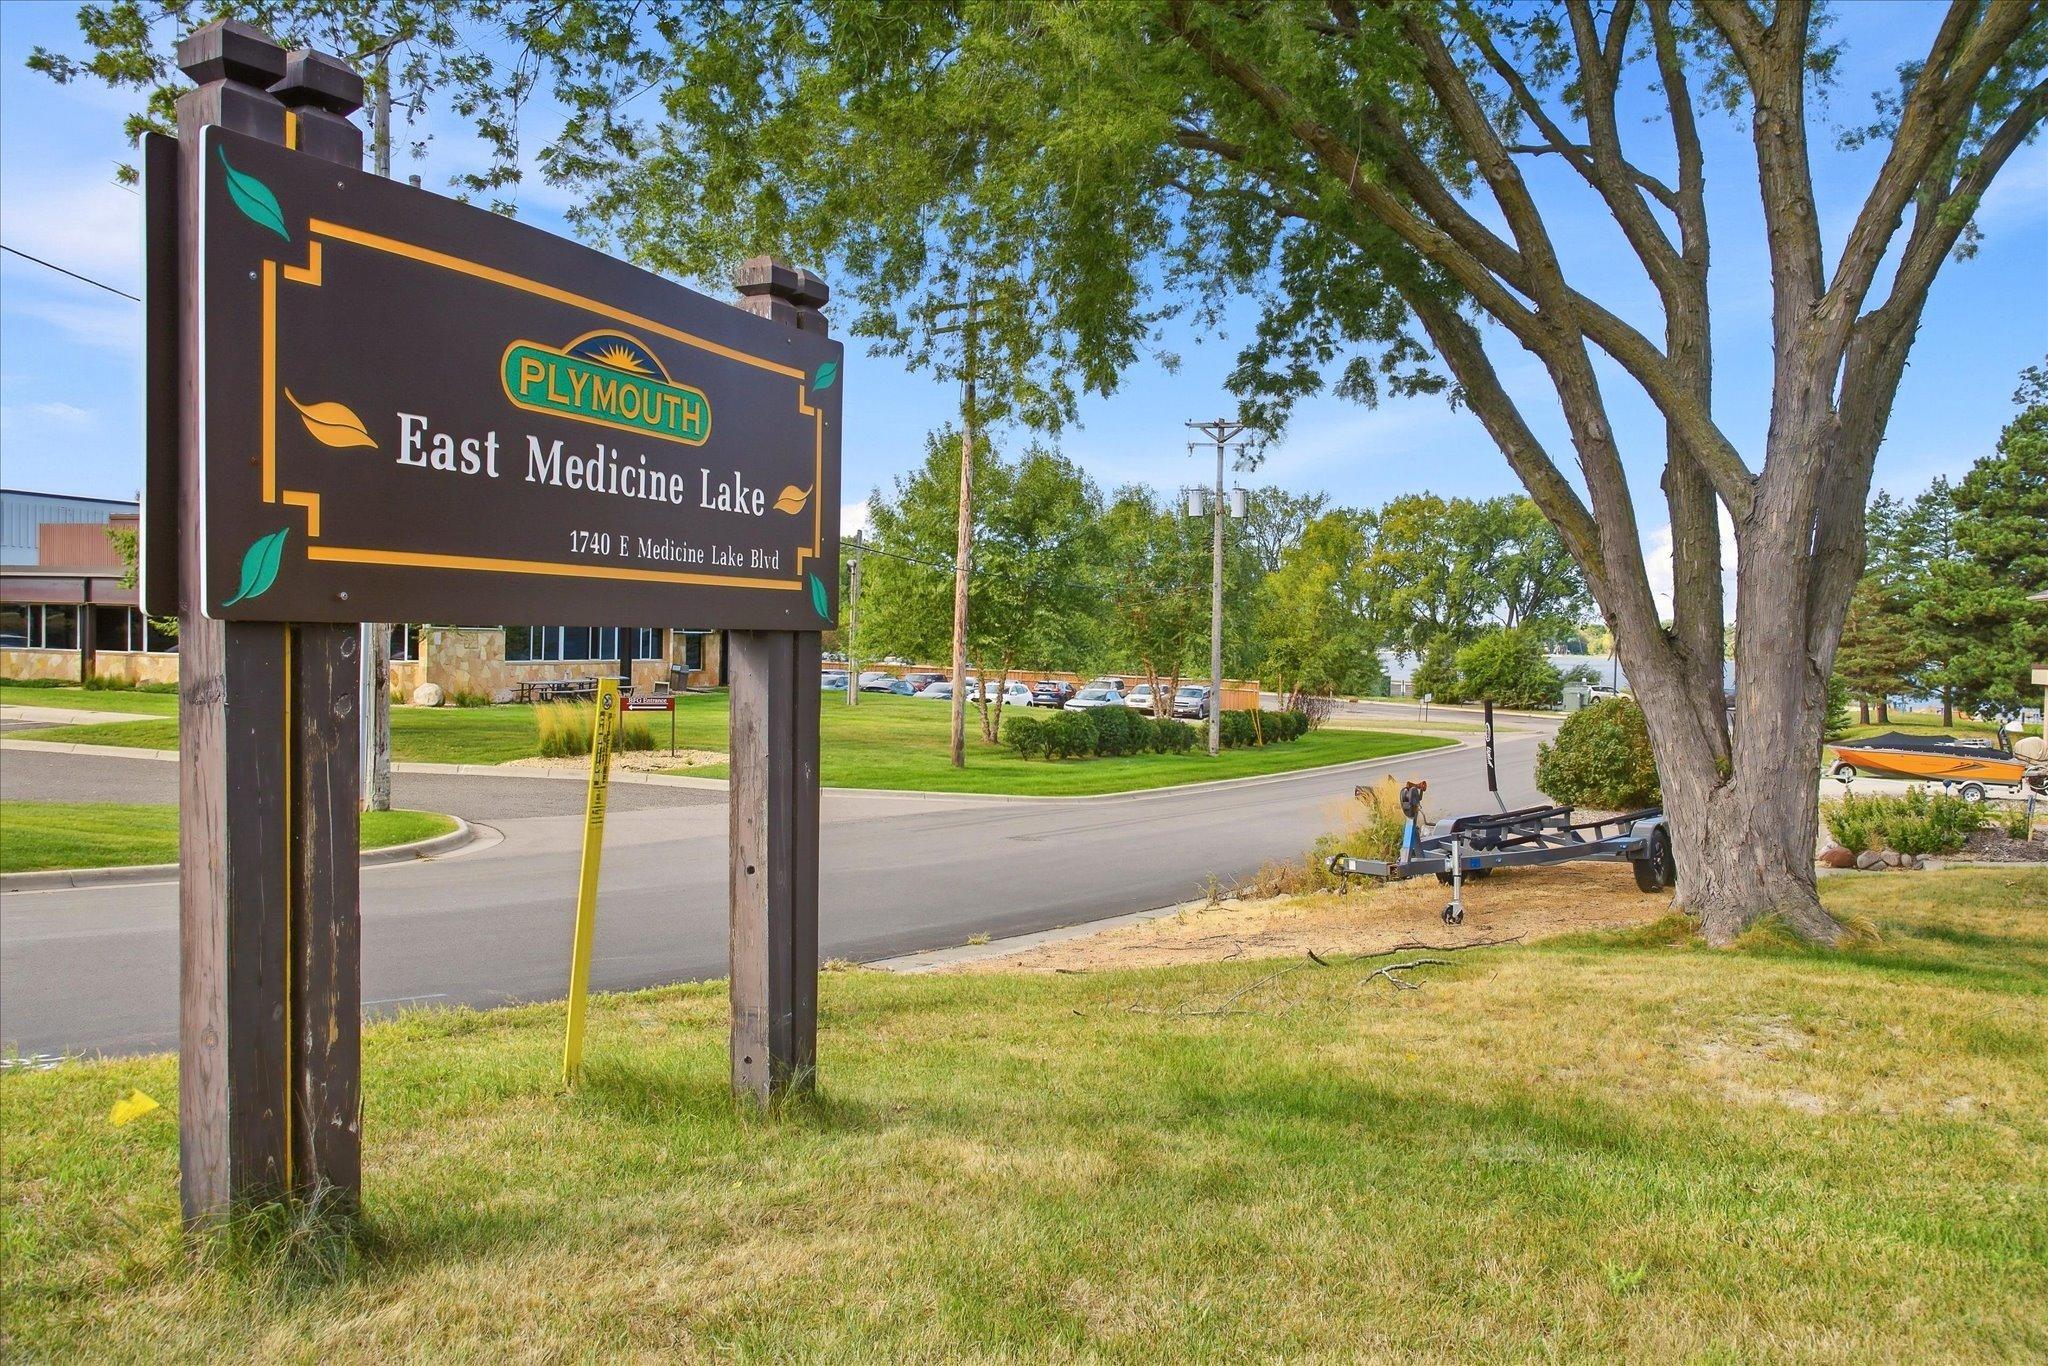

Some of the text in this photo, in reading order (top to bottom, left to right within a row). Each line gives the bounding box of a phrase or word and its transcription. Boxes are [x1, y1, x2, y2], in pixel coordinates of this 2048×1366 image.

[519, 356, 701, 435] PLYMOUTH
[395, 411, 766, 517] East Medicine Lake
[569, 529, 780, 570] 1740 E Medicine Lake Blvd
